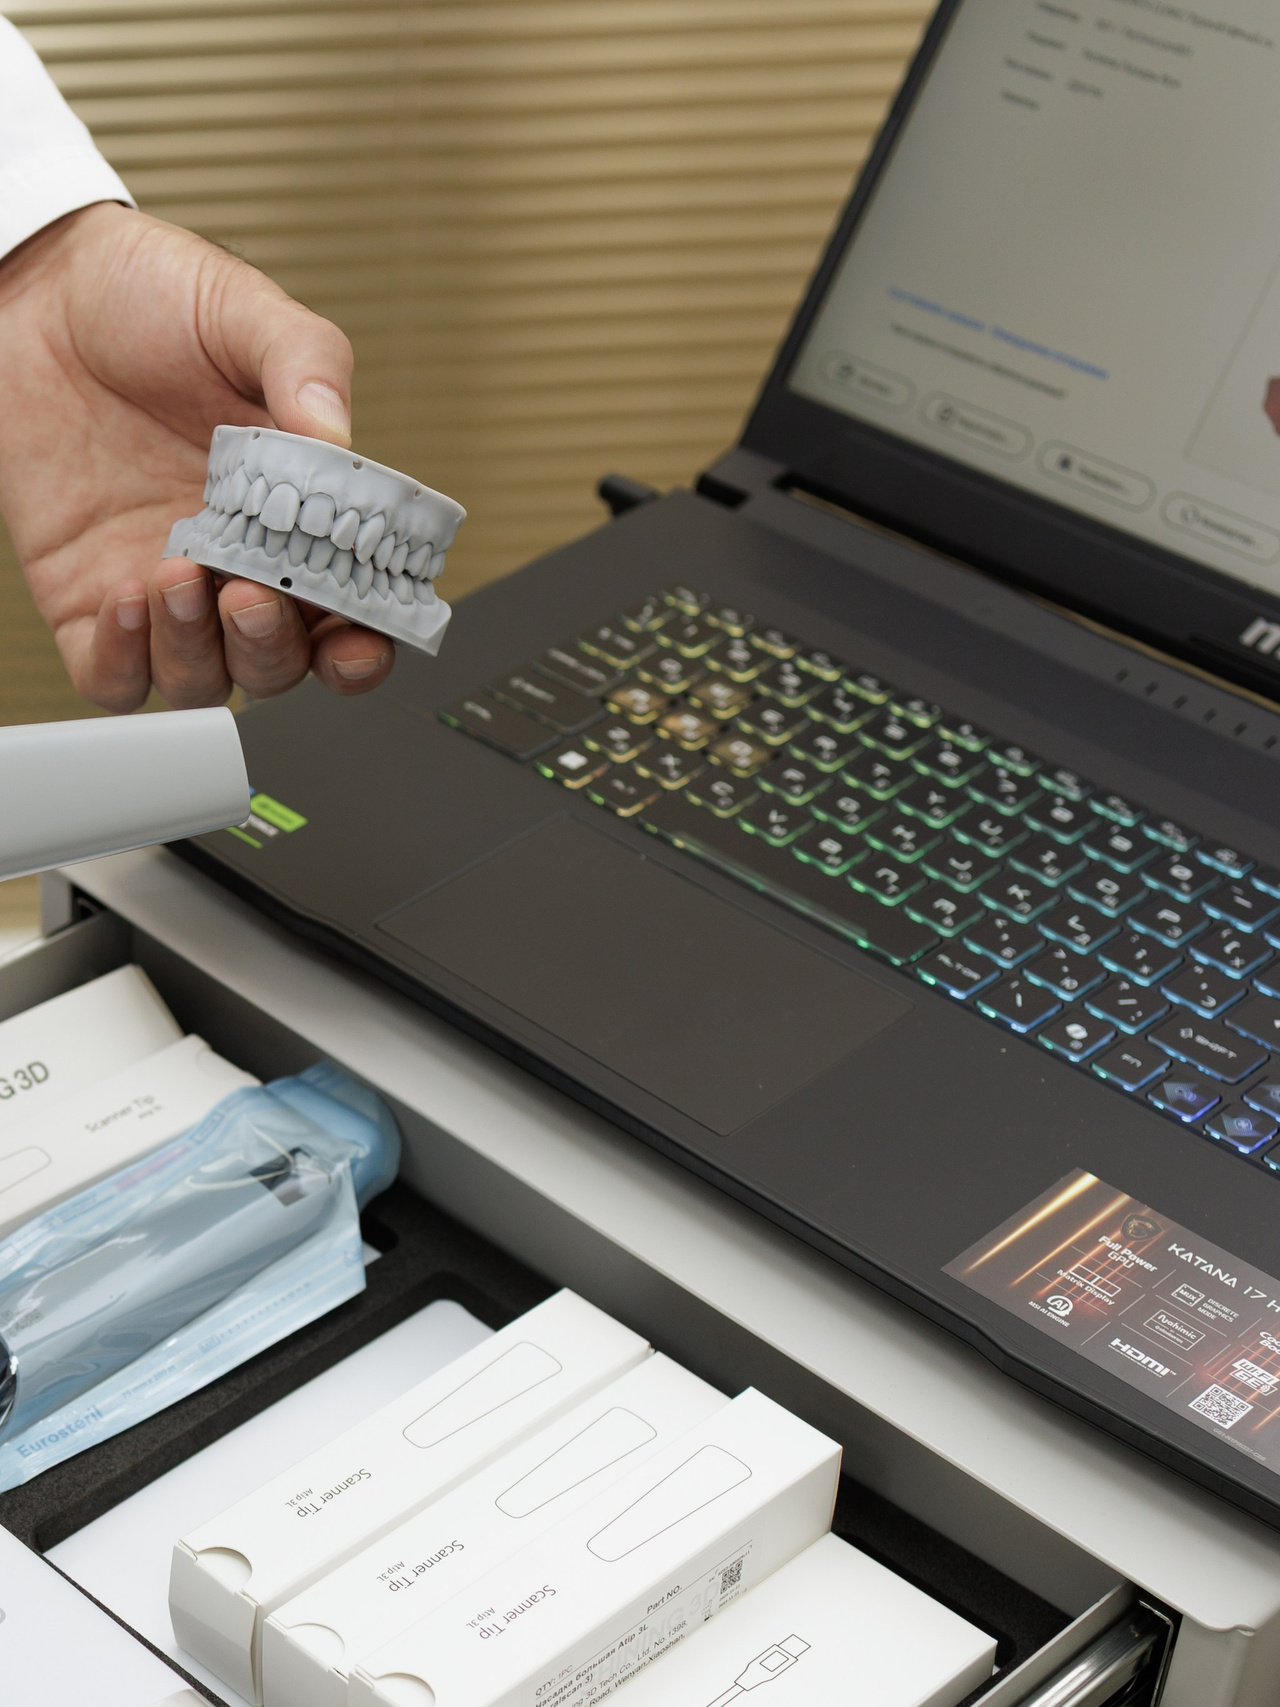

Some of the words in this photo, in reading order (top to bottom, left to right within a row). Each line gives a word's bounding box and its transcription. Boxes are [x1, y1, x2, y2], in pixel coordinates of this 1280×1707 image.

[18, 1061, 50, 1091] 3D
[84, 1105, 132, 1136] Scanner
[132, 1094, 156, 1114] Tip
[1098, 1235, 1123, 1252] Full
[1121, 1247, 1158, 1272] Power
[1107, 1250, 1135, 1269] GPU
[1167, 1243, 1238, 1288] KATANA
[1243, 1286, 1267, 1299] 17
[1057, 1269, 1085, 1288] Matrix
[1084, 1283, 1115, 1306] Display
[1179, 1289, 1198, 1302] MUX
[1028, 1301, 1041, 1311] MSI
[1047, 1311, 1070, 1328] ENGINE
[1197, 1307, 1218, 1321] MODE
[1202, 1302, 1235, 1323] GRAPHICS
[1207, 1298, 1240, 1319] DISCRETE
[1158, 1314, 1197, 1340] Nahimic
[16, 1405, 105, 1459] Eurosteril
[295, 1487, 314, 1501] Atip
[319, 1468, 372, 1504] Scanner
[284, 1498, 298, 1509] 3L
[296, 1505, 323, 1519] Tip
[387, 1560, 406, 1575] Atip
[411, 1539, 465, 1578] Scanner
[375, 1572, 390, 1583] 3L
[388, 1576, 415, 1592] Tip
[476, 1606, 496, 1622] Atip
[502, 1584, 557, 1624] Scanner
[646, 1596, 665, 1614] Part
[465, 1618, 480, 1629] 3L
[478, 1622, 506, 1640] Tip
[575, 1648, 616, 1681] большая
[618, 1632, 636, 1651] Atip
[637, 1623, 649, 1636] 3L
[585, 1687, 597, 1699] 3D
[599, 1671, 618, 1689] Tech
[654, 1636, 667, 1649] No.
[535, 1677, 557, 1697] QTY:
